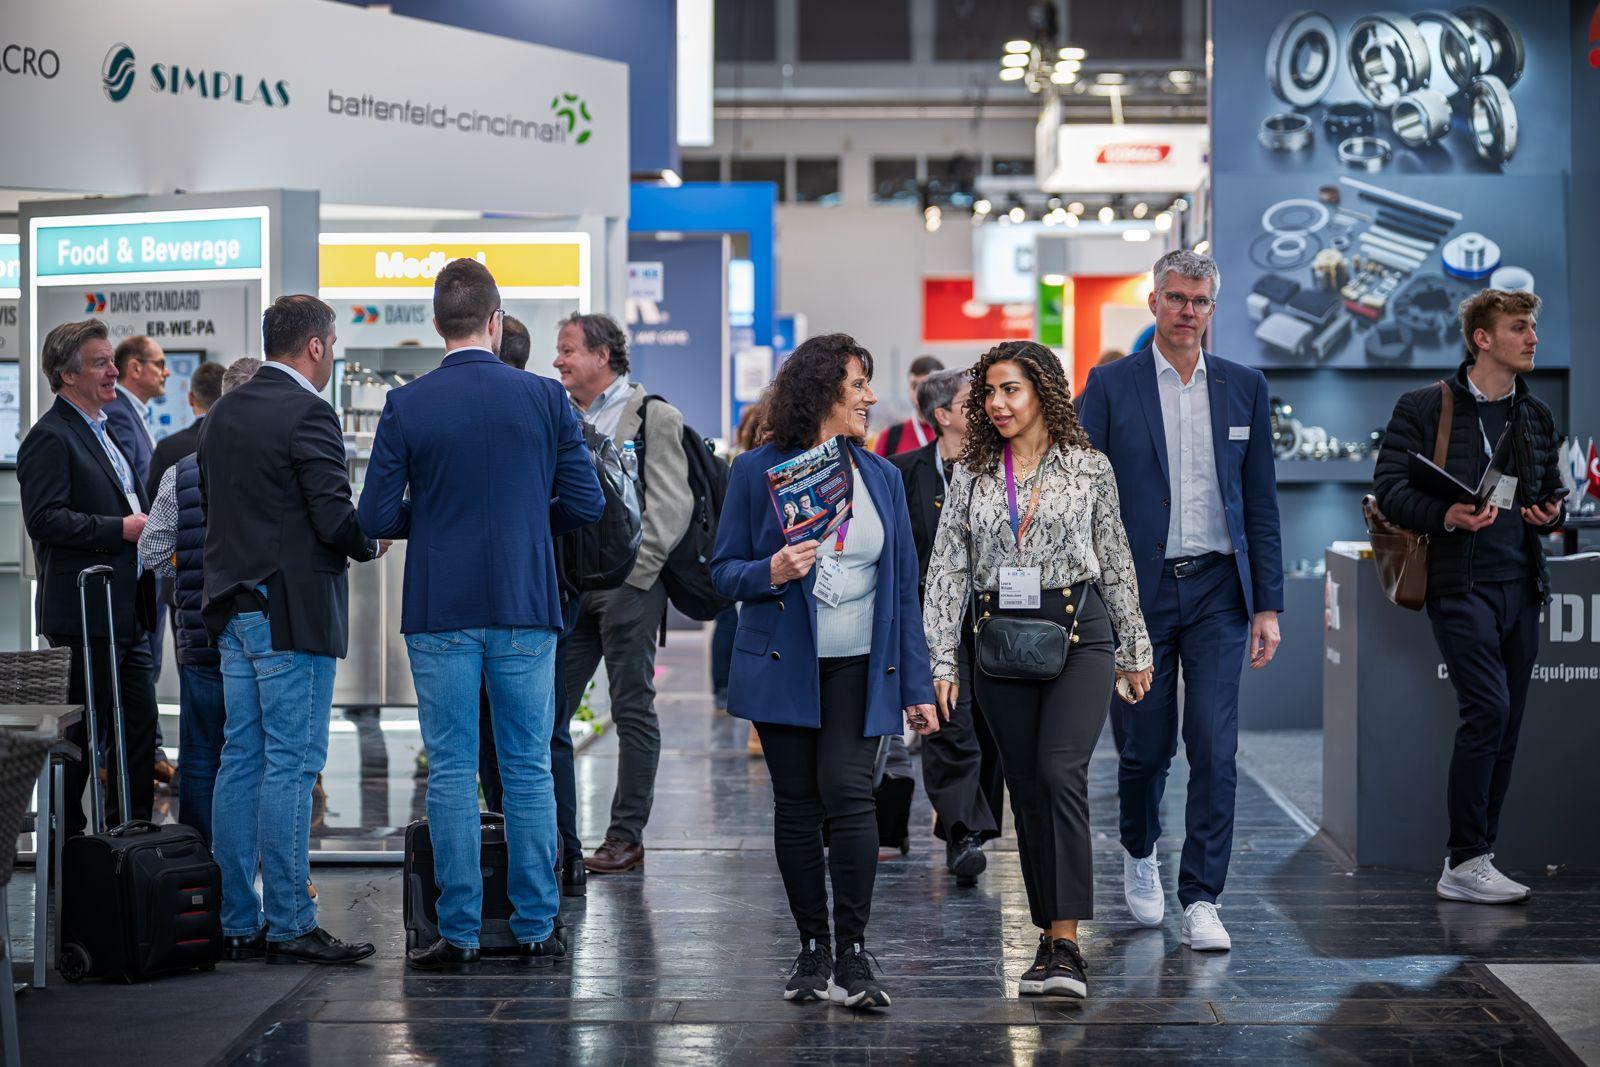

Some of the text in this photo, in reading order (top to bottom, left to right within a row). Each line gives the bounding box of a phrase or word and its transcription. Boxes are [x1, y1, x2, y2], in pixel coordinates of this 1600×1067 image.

[0, 44, 60, 79] CRO
[150, 62, 290, 107] SIMPLAS
[328, 88, 567, 144] battenfeld-cincinnati
[57, 235, 240, 266] Food & Beverage
[1530, 663, 1600, 683] Equipme
